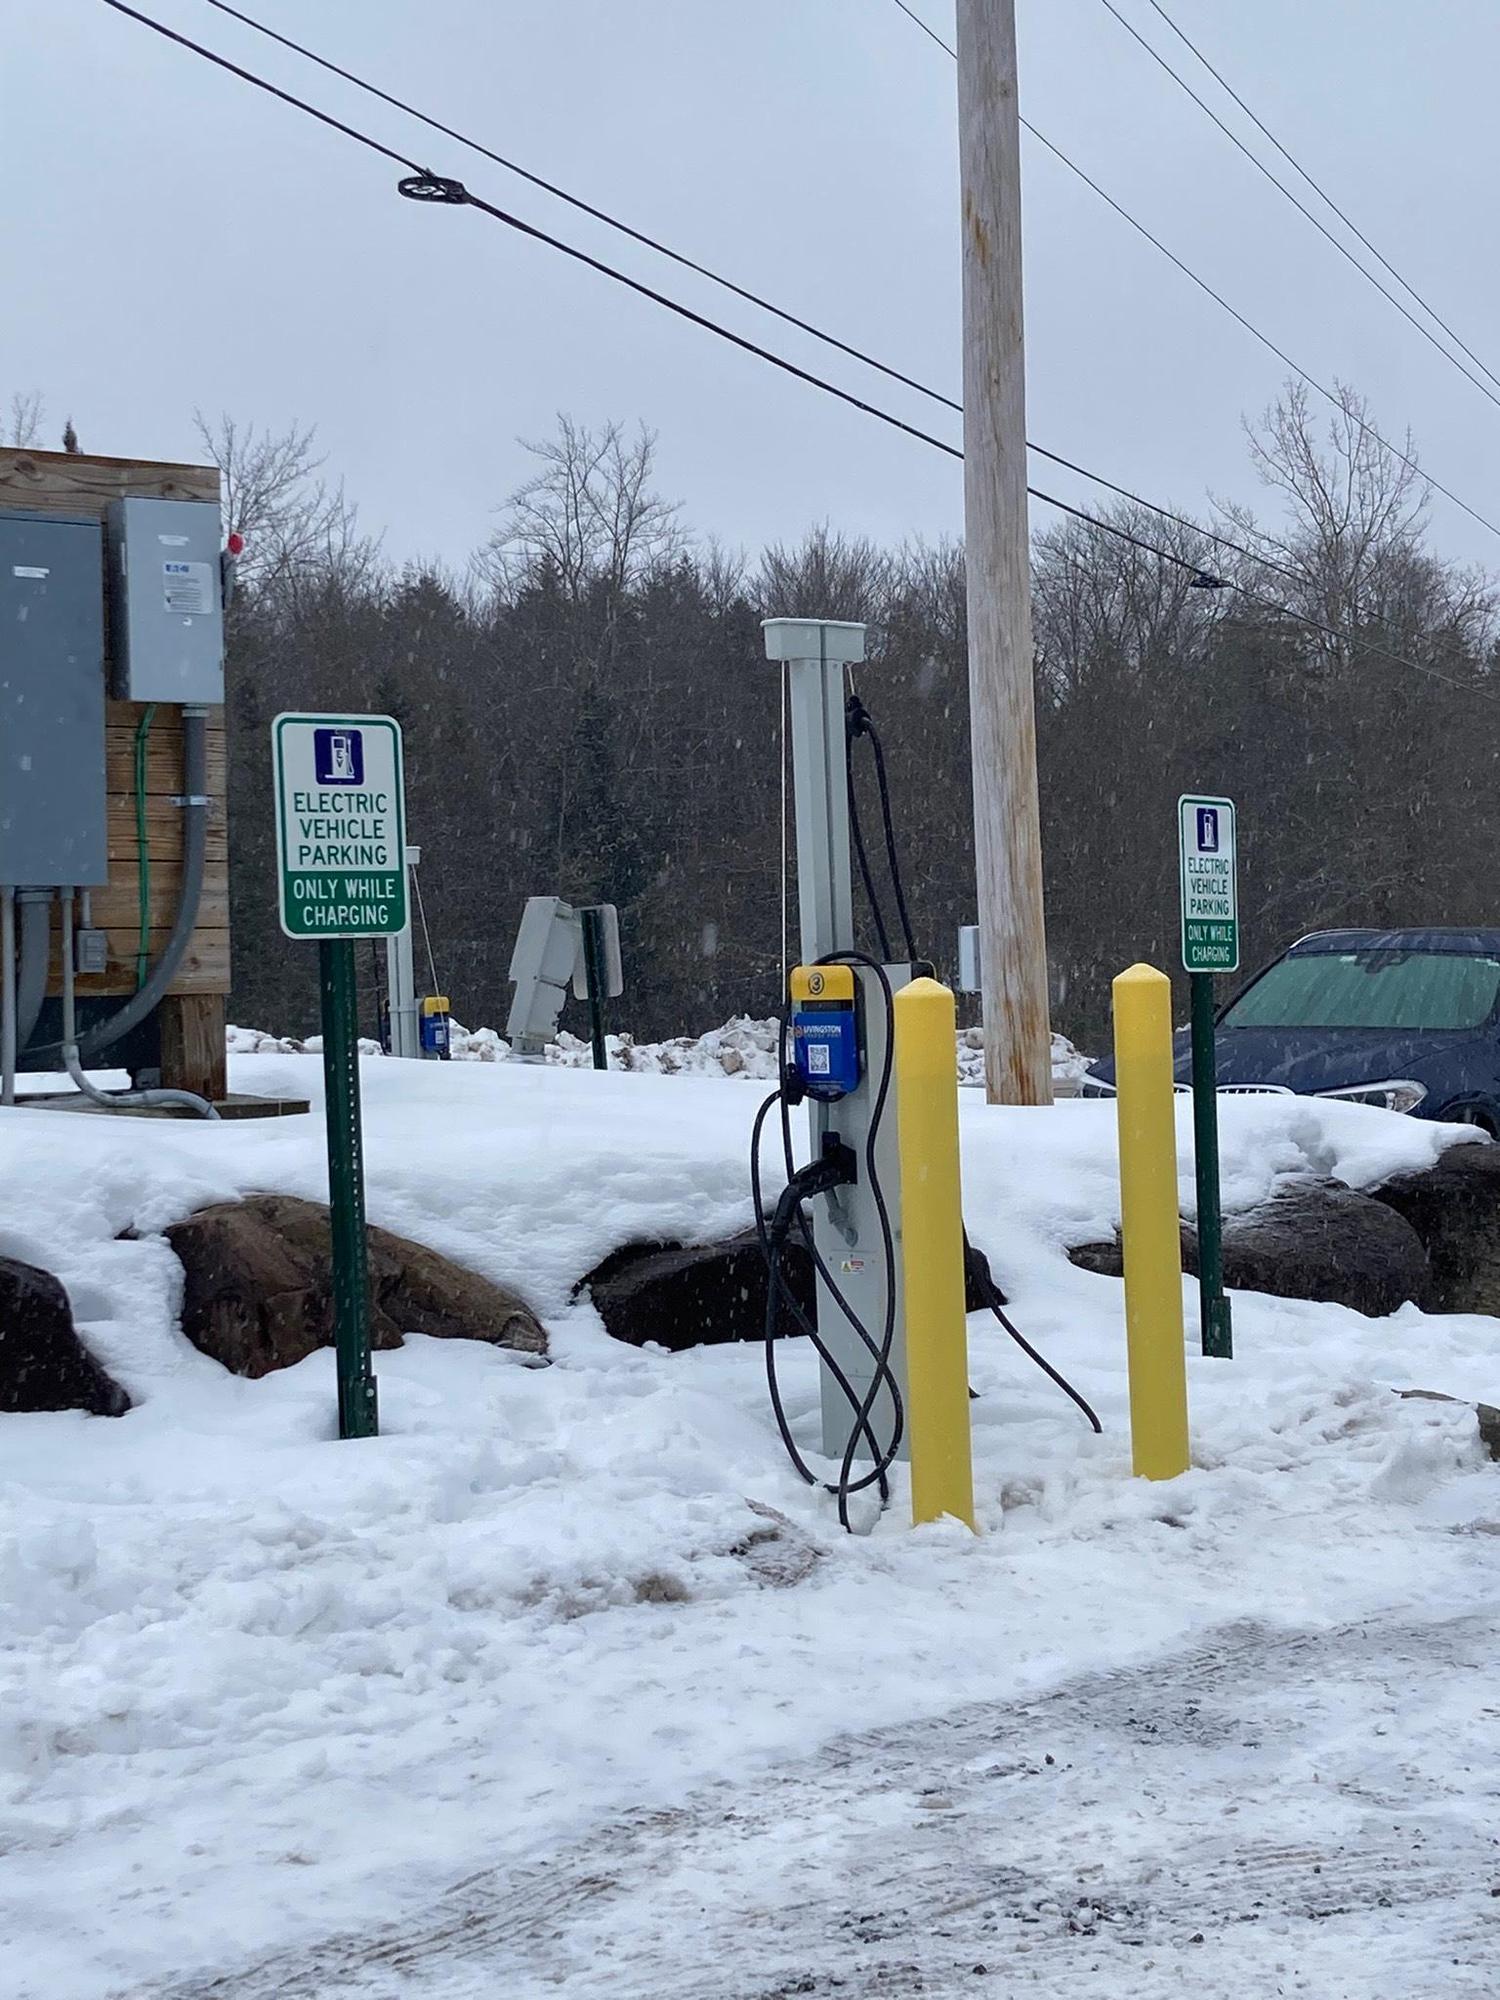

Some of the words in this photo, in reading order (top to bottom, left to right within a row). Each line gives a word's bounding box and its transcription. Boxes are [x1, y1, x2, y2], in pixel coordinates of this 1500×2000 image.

[293, 792, 388, 813] ELECTRIC
[299, 819, 385, 839] VEHICLE
[299, 845, 388, 865] PARKING
[1188, 857, 1229, 875] ELECTRIC
[293, 879, 339, 899] ONLY
[345, 878, 395, 898] WHILE
[1190, 878, 1228, 895] VEHICLE
[303, 905, 388, 926] CHARGING
[1190, 899, 1229, 916] PARKING
[1188, 925, 1208, 941] ONLY
[1210, 925, 1233, 942] WHILE
[1192, 946, 1230, 962] CHARGING
